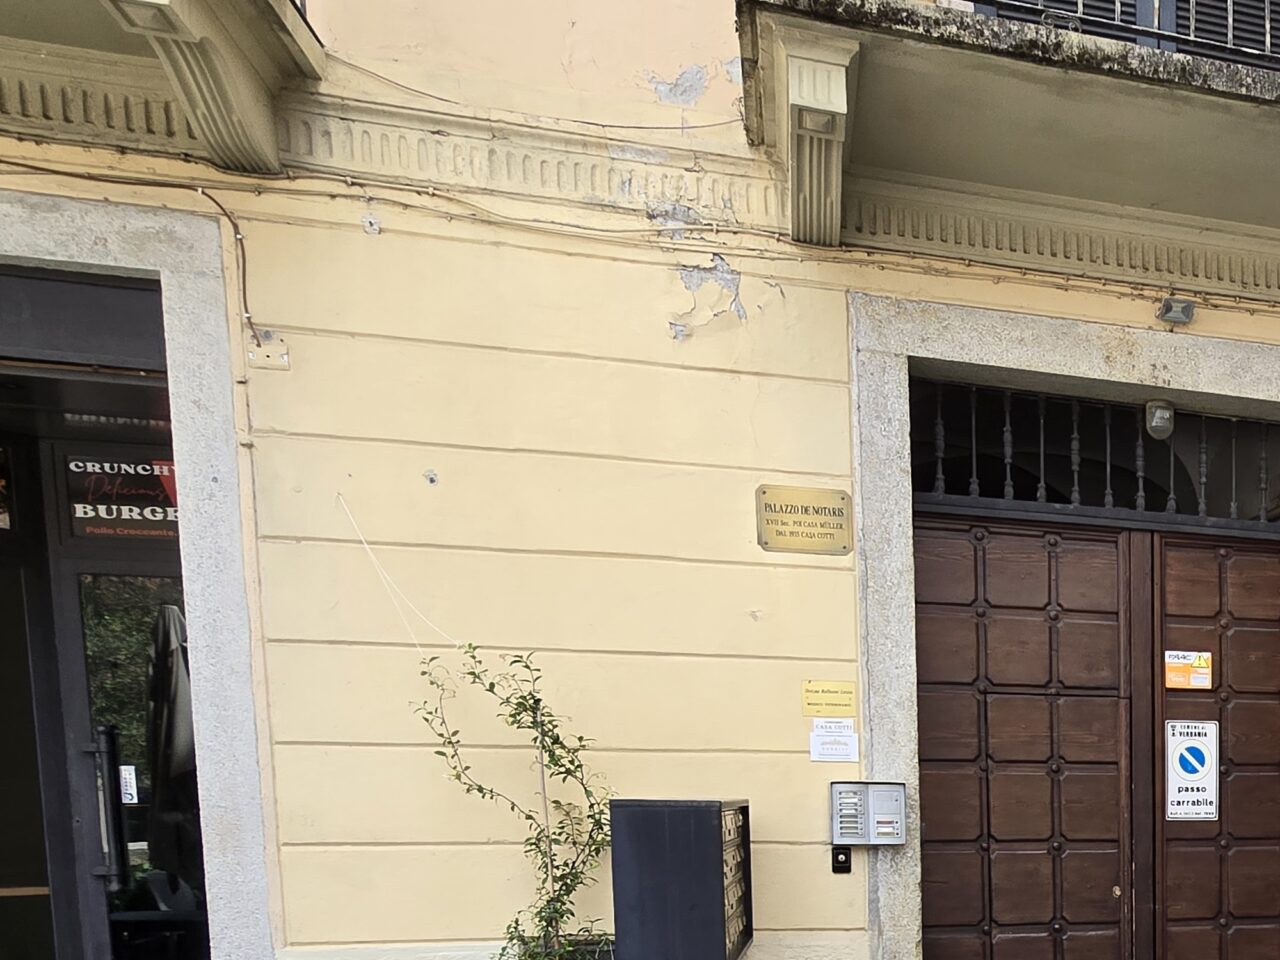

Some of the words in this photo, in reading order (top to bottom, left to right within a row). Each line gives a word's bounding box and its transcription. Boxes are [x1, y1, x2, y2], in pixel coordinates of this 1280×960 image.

[73, 503, 179, 521] BURGE
[764, 503, 800, 514] PALAZZO
[801, 505, 811, 515] DE
[812, 506, 844, 517] NOTARIS
[801, 531, 816, 539] CASA
[1177, 786, 1207, 794] passo
[1170, 798, 1214, 806] carrabile
